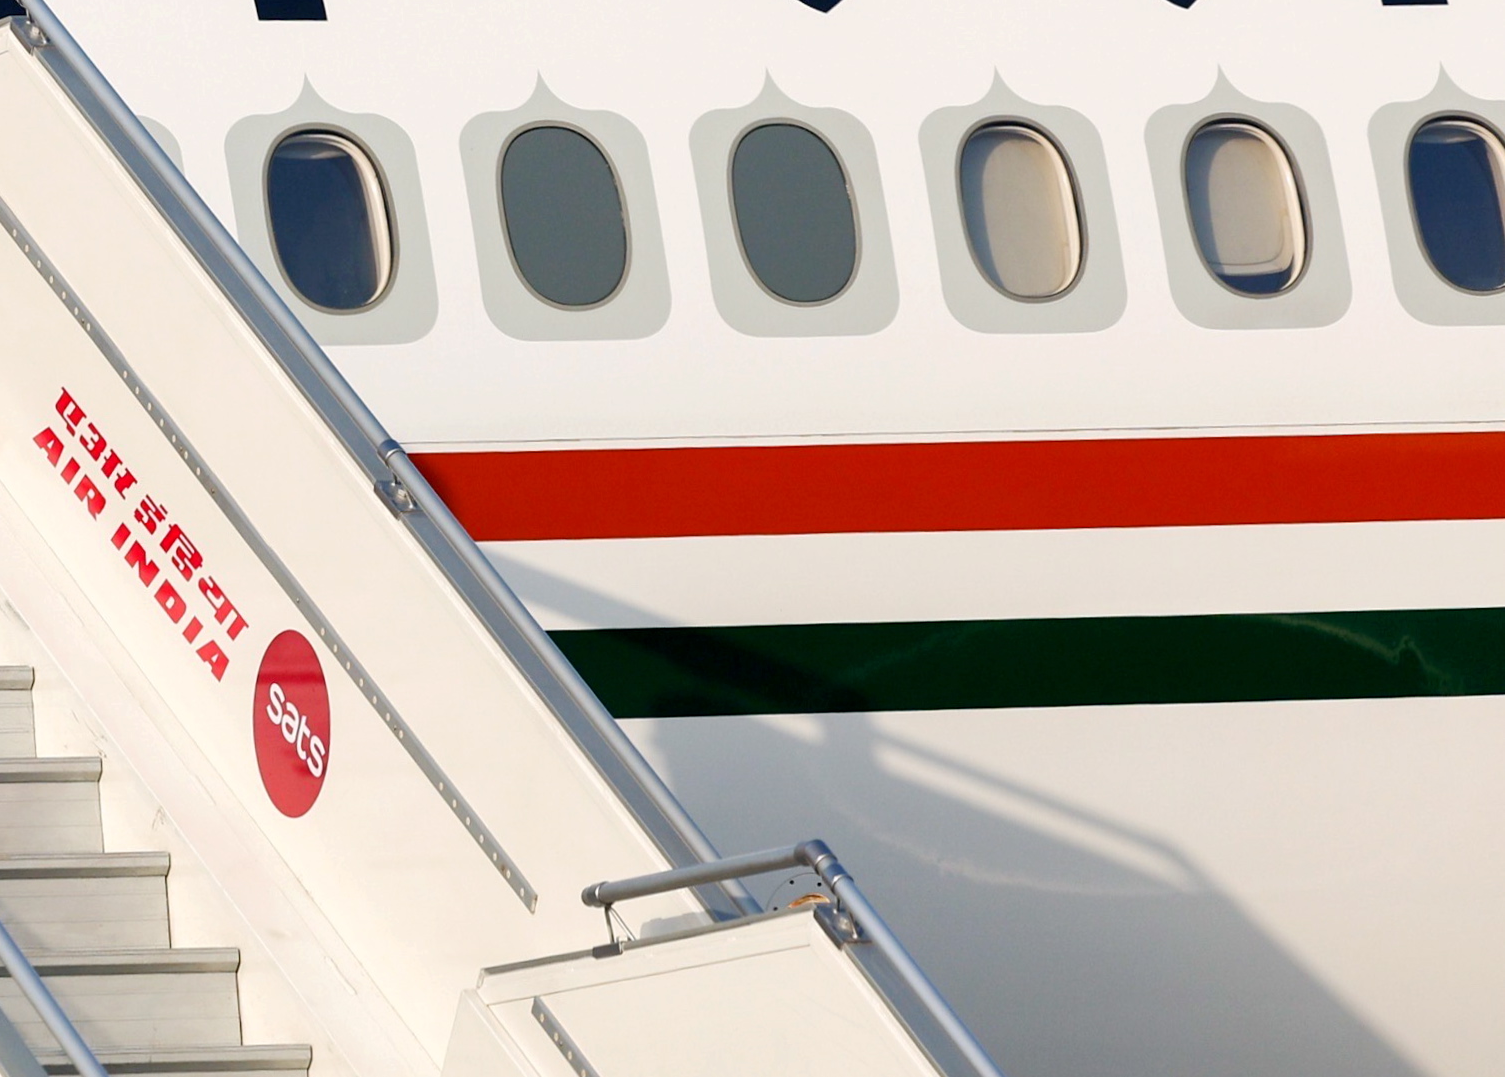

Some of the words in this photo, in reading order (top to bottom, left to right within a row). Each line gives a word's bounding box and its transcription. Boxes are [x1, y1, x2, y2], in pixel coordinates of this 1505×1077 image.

[33, 427, 107, 521] AIR
[111, 523, 230, 682] INDIA
[266, 682, 326, 778] sats
